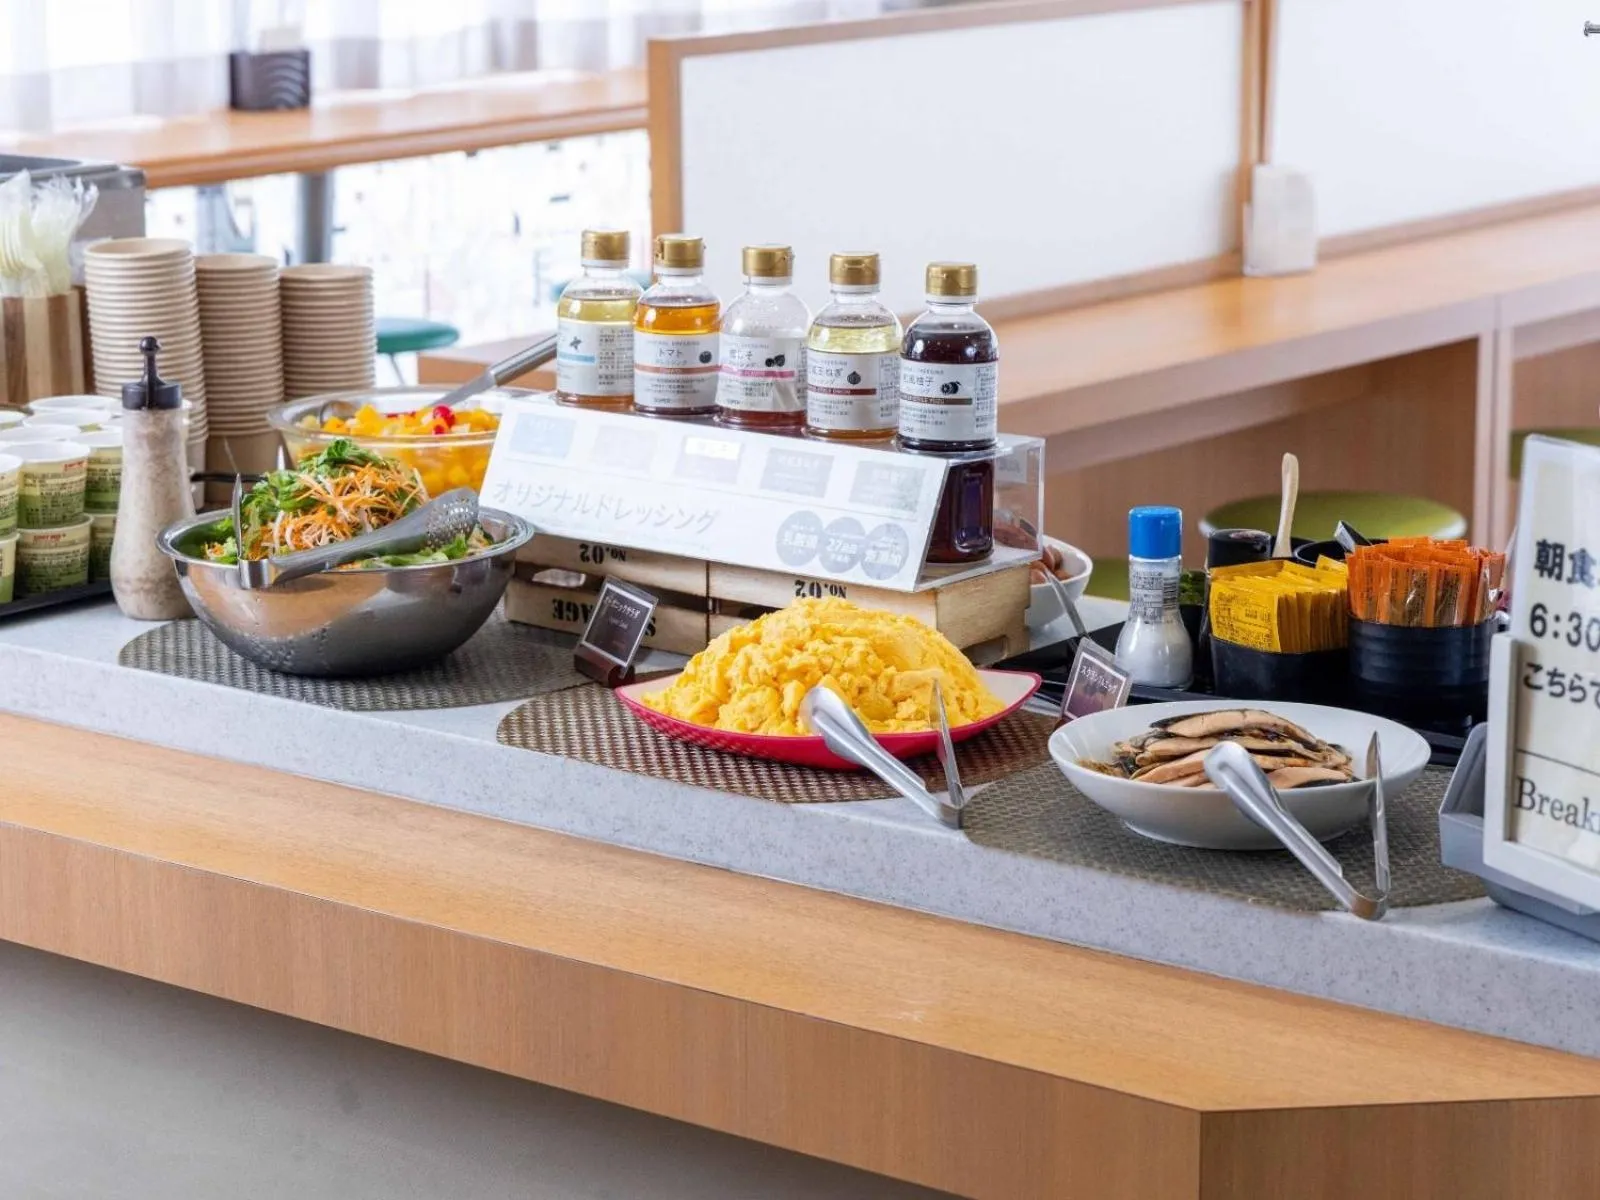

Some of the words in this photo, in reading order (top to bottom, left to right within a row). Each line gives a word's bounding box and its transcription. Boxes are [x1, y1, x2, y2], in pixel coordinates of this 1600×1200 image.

[493, 478, 721, 534] オリジナルドレッシング
[1534, 539, 1600, 588] 朝食
[1529, 603, 1600, 652] 6:30
